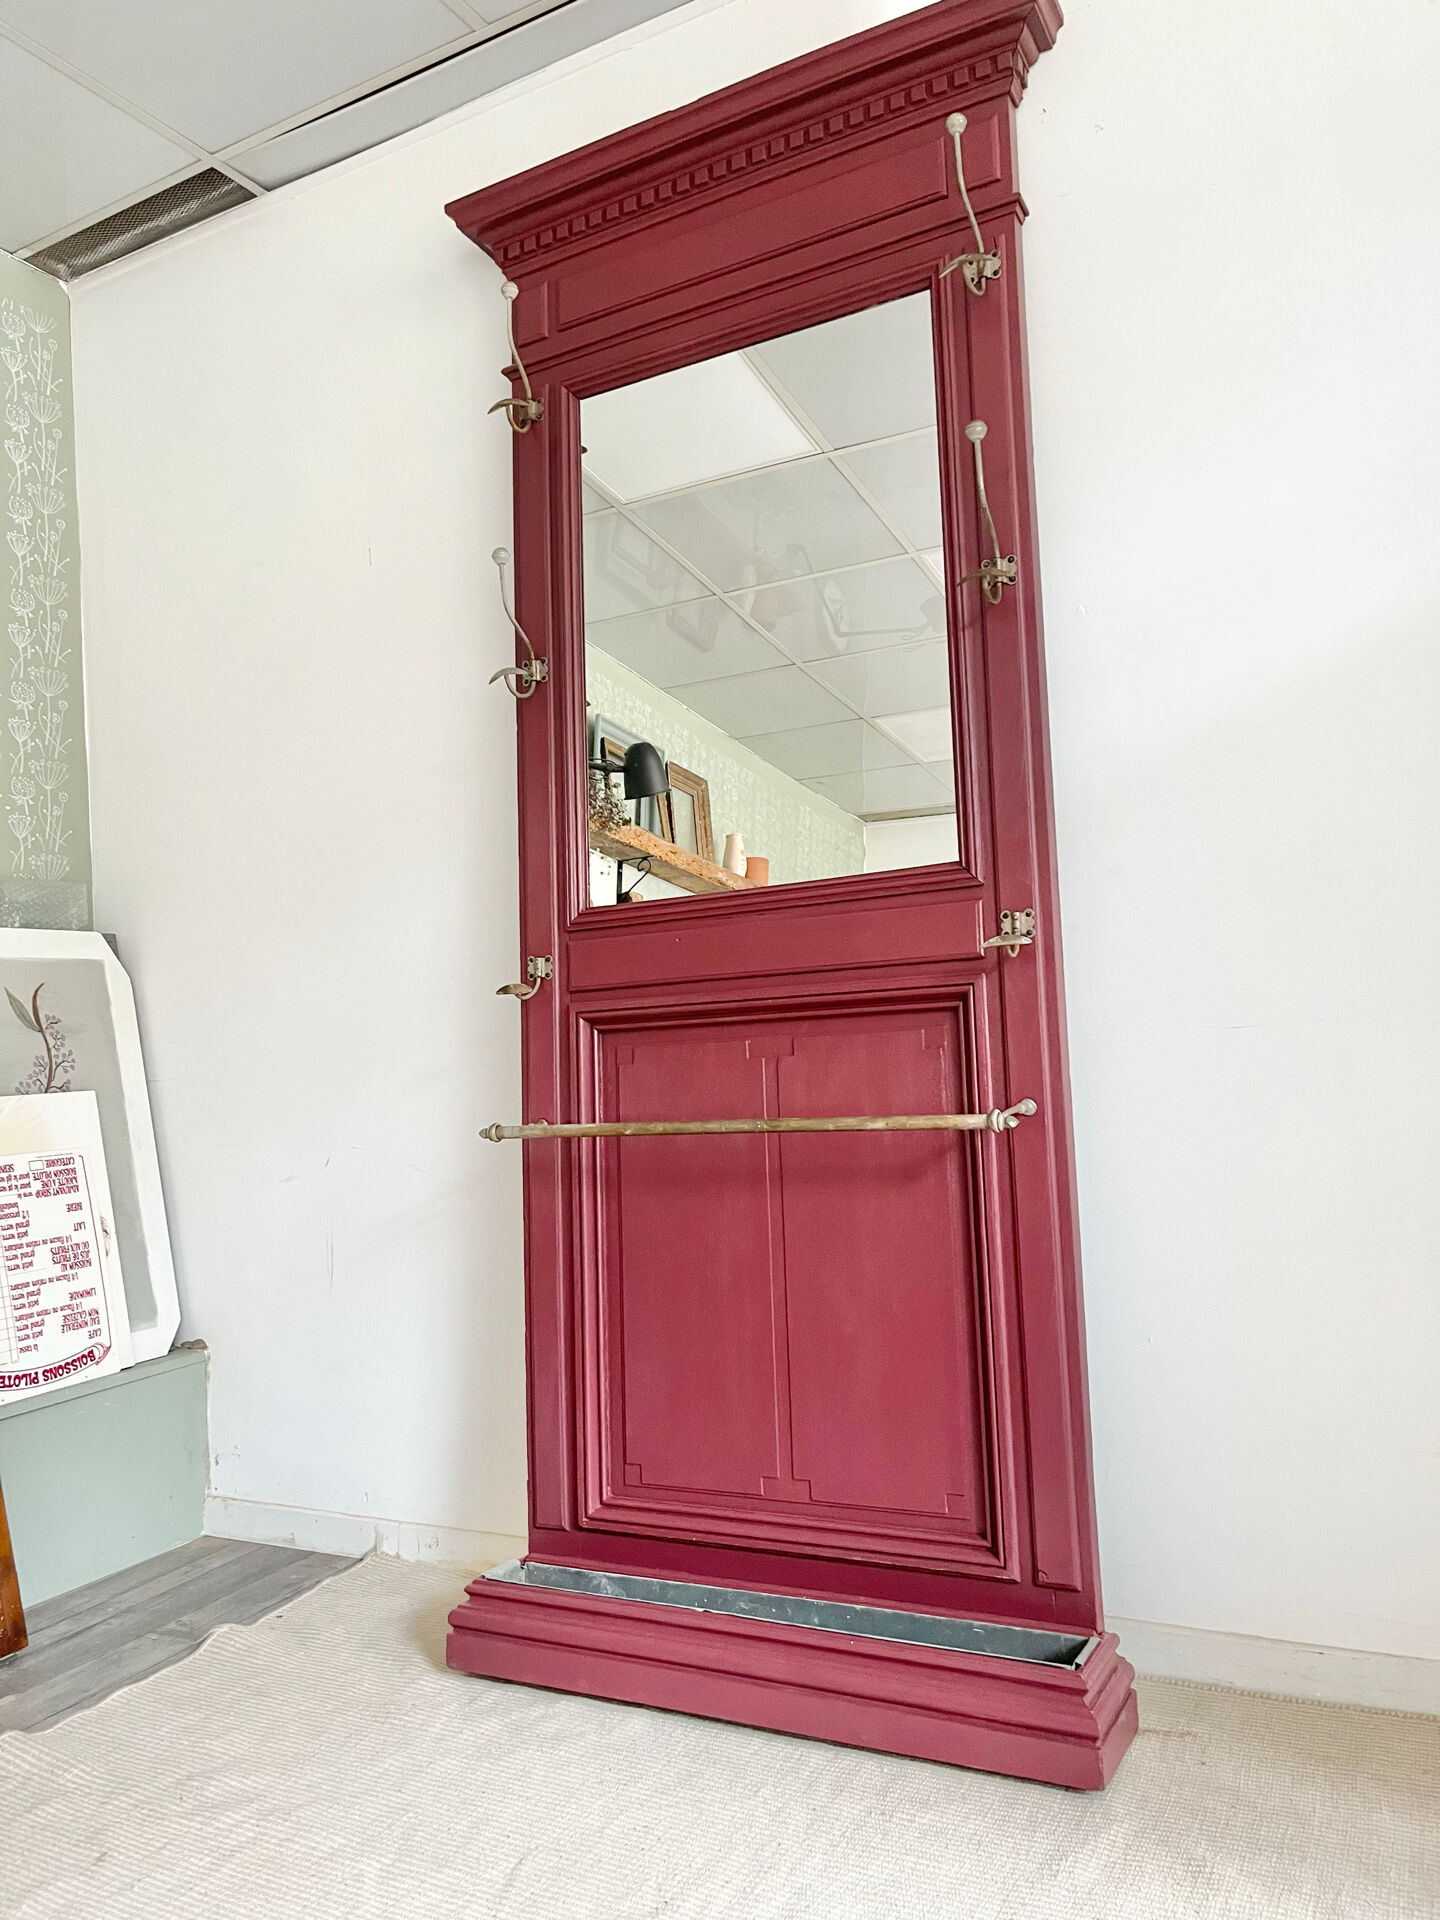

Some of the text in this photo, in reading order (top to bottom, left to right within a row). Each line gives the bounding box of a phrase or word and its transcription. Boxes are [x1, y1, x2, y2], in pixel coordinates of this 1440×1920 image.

[45, 1157, 75, 1168] CATEGORIE
[32, 1167, 77, 1181] BOISSON PILOTE
[42, 1180, 52, 1188] UNE
[0, 1223, 14, 1231] verre
[73, 1221, 86, 1232] LAIT
[51, 1245, 70, 1256] FRUITS
[70, 1243, 81, 1252] AUX
[20, 1250, 35, 1261] grand
[52, 1253, 71, 1265] FRUITS
[22, 1260, 34, 1270] petit
[69, 1258, 92, 1270] BOISSON
[12, 1288, 41, 1301] grand verre
[68, 1288, 97, 1301] LIMONADE
[27, 1299, 39, 1309] petit
[63, 1307, 99, 1323] NON GAZEUSE
[16, 1318, 45, 1332] grand verre
[61, 1317, 100, 1333] EAU MINERALE
[18, 1329, 43, 1342] petit verre
[19, 1345, 32, 1353] tasse
[42, 1349, 96, 1382] BOISSONS
